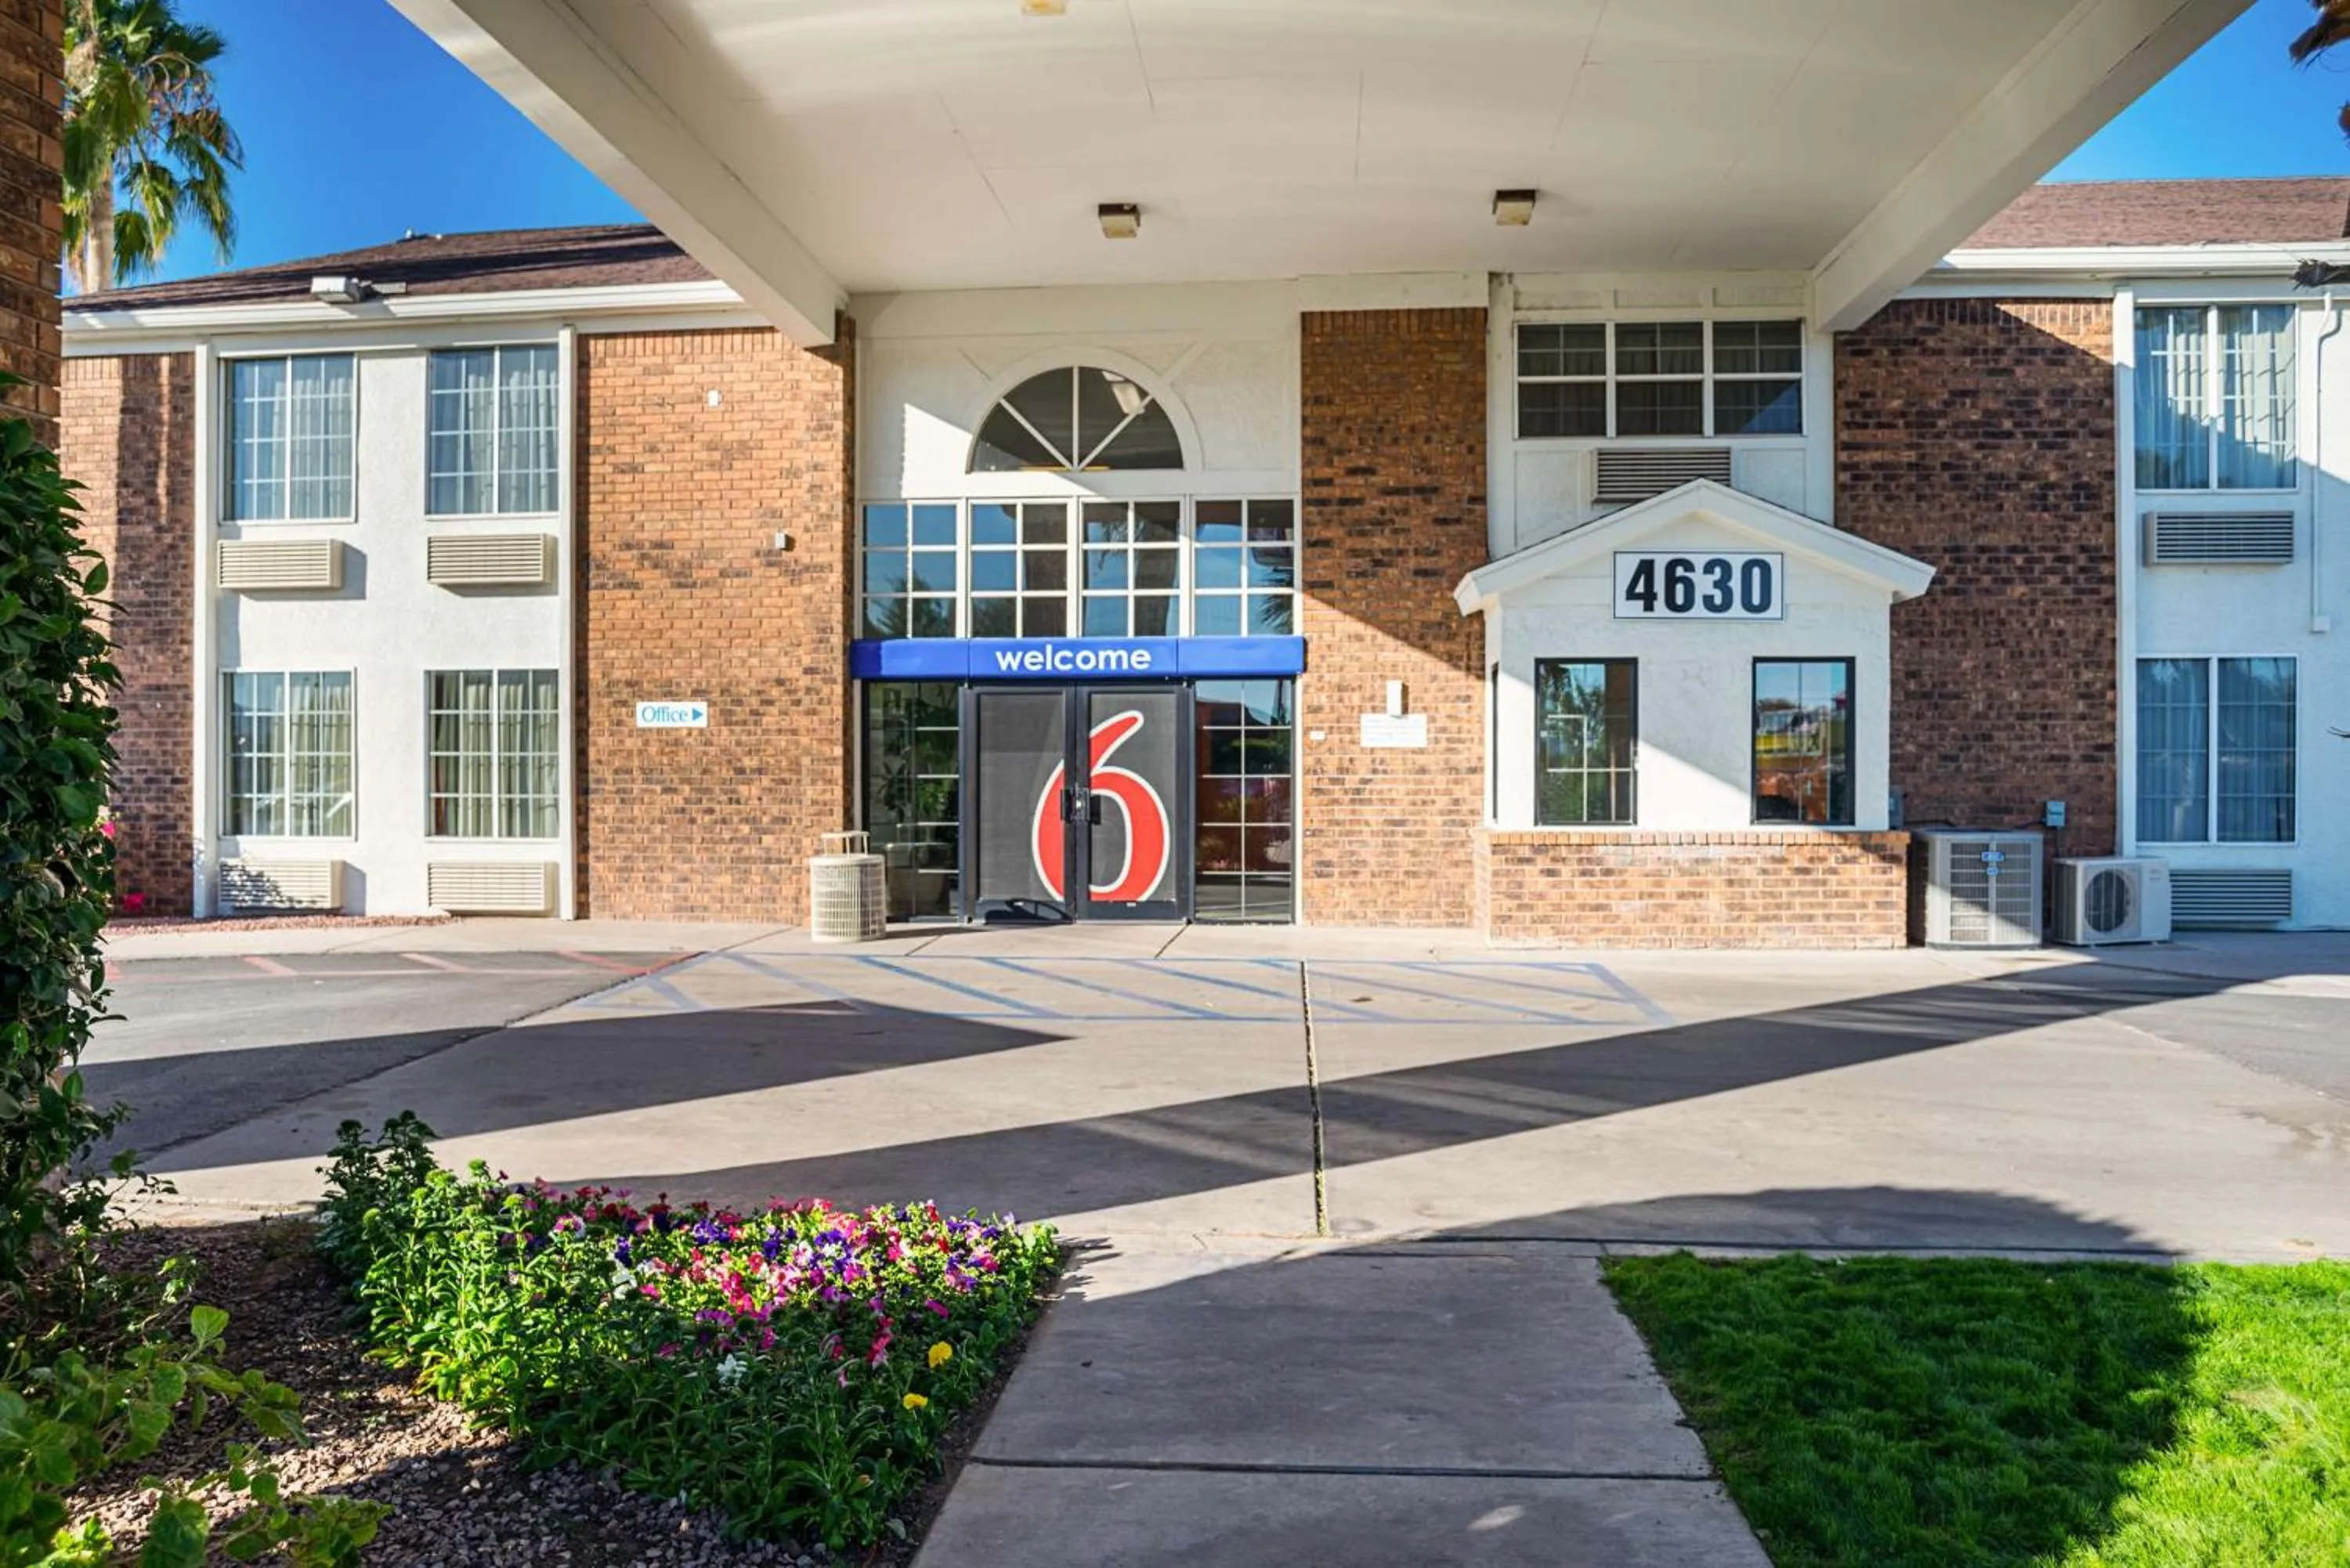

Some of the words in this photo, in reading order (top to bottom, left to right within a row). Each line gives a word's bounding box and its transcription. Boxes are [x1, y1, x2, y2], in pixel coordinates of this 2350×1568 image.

[1625, 558, 1772, 613] 4630
[995, 644, 1152, 670] welcome
[642, 706, 689, 722] Office
[1032, 710, 1170, 902] 6
